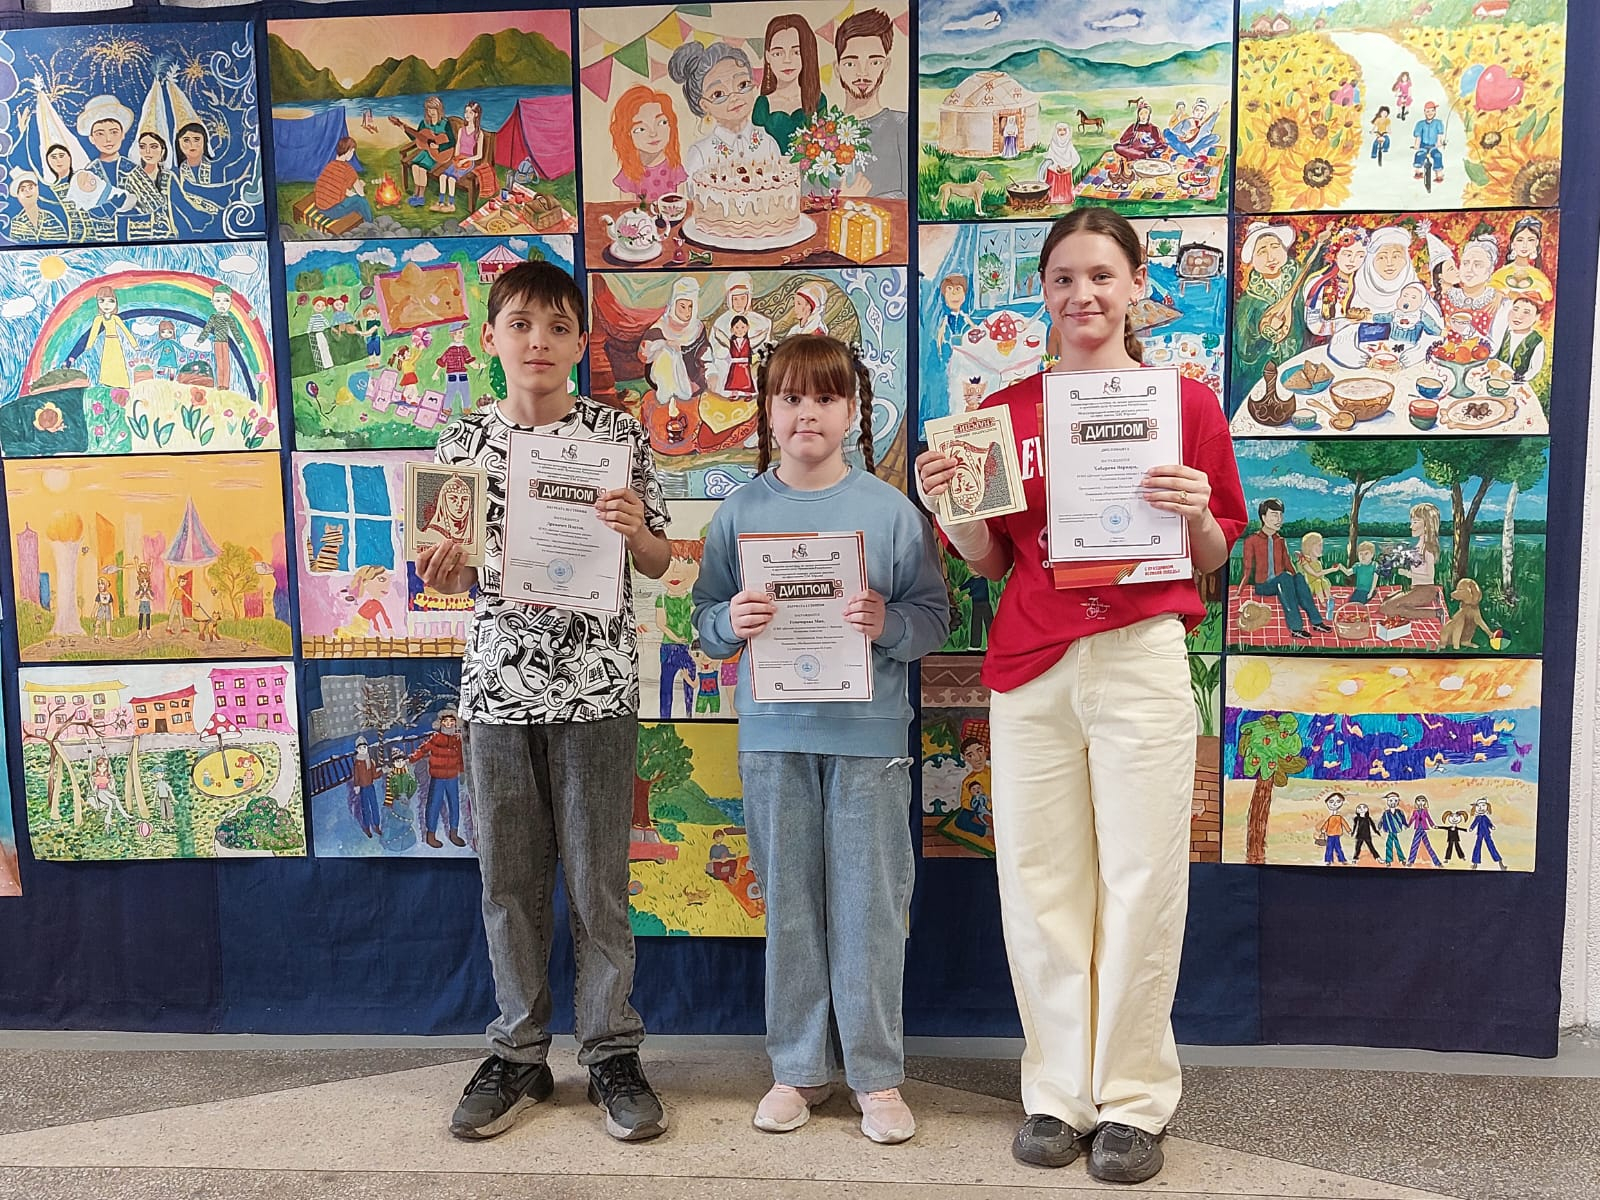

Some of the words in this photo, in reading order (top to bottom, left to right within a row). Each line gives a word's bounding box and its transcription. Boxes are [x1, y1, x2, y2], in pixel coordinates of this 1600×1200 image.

[1085, 423, 1144, 440] ДИПЛОМ
[541, 484, 594, 502] ДИПЛОМ
[779, 583, 831, 598] ДИПЛОМ
